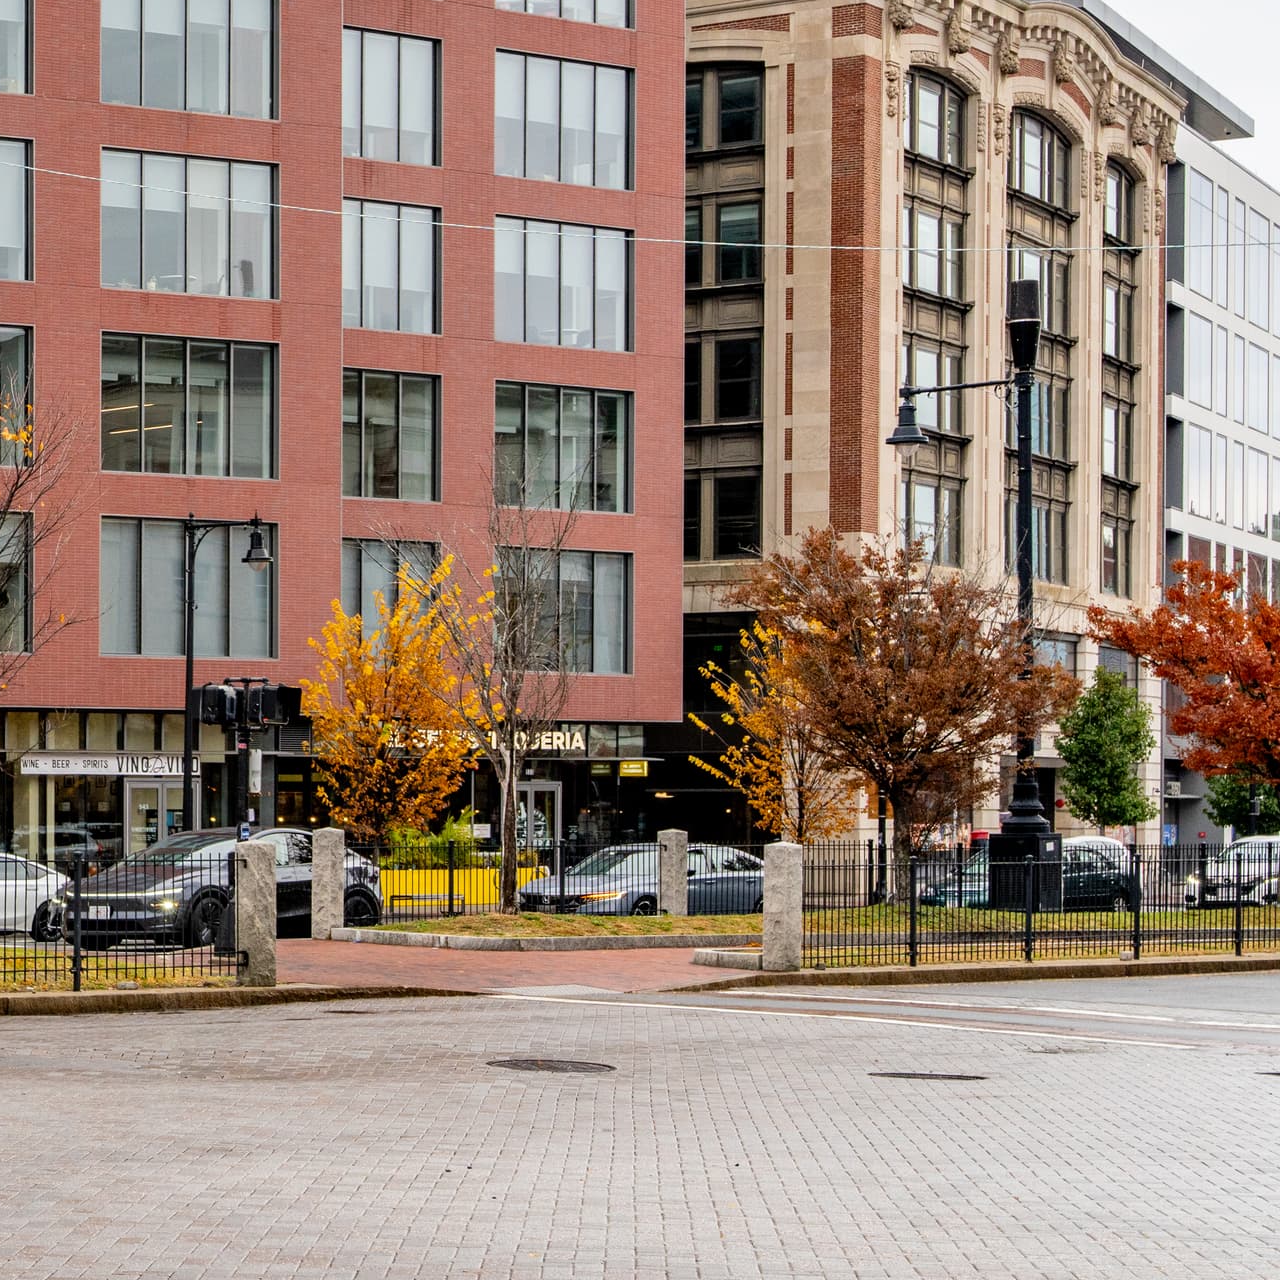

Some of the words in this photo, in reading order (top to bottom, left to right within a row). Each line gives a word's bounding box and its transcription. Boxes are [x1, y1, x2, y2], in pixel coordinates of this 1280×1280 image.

[488, 731, 586, 750] TQUERIA
[22, 759, 40, 769] WINE
[52, 759, 70, 769] BEER
[82, 759, 109, 769] SPIRITS
[116, 756, 149, 773] VINO
[167, 756, 199, 773] VIO
